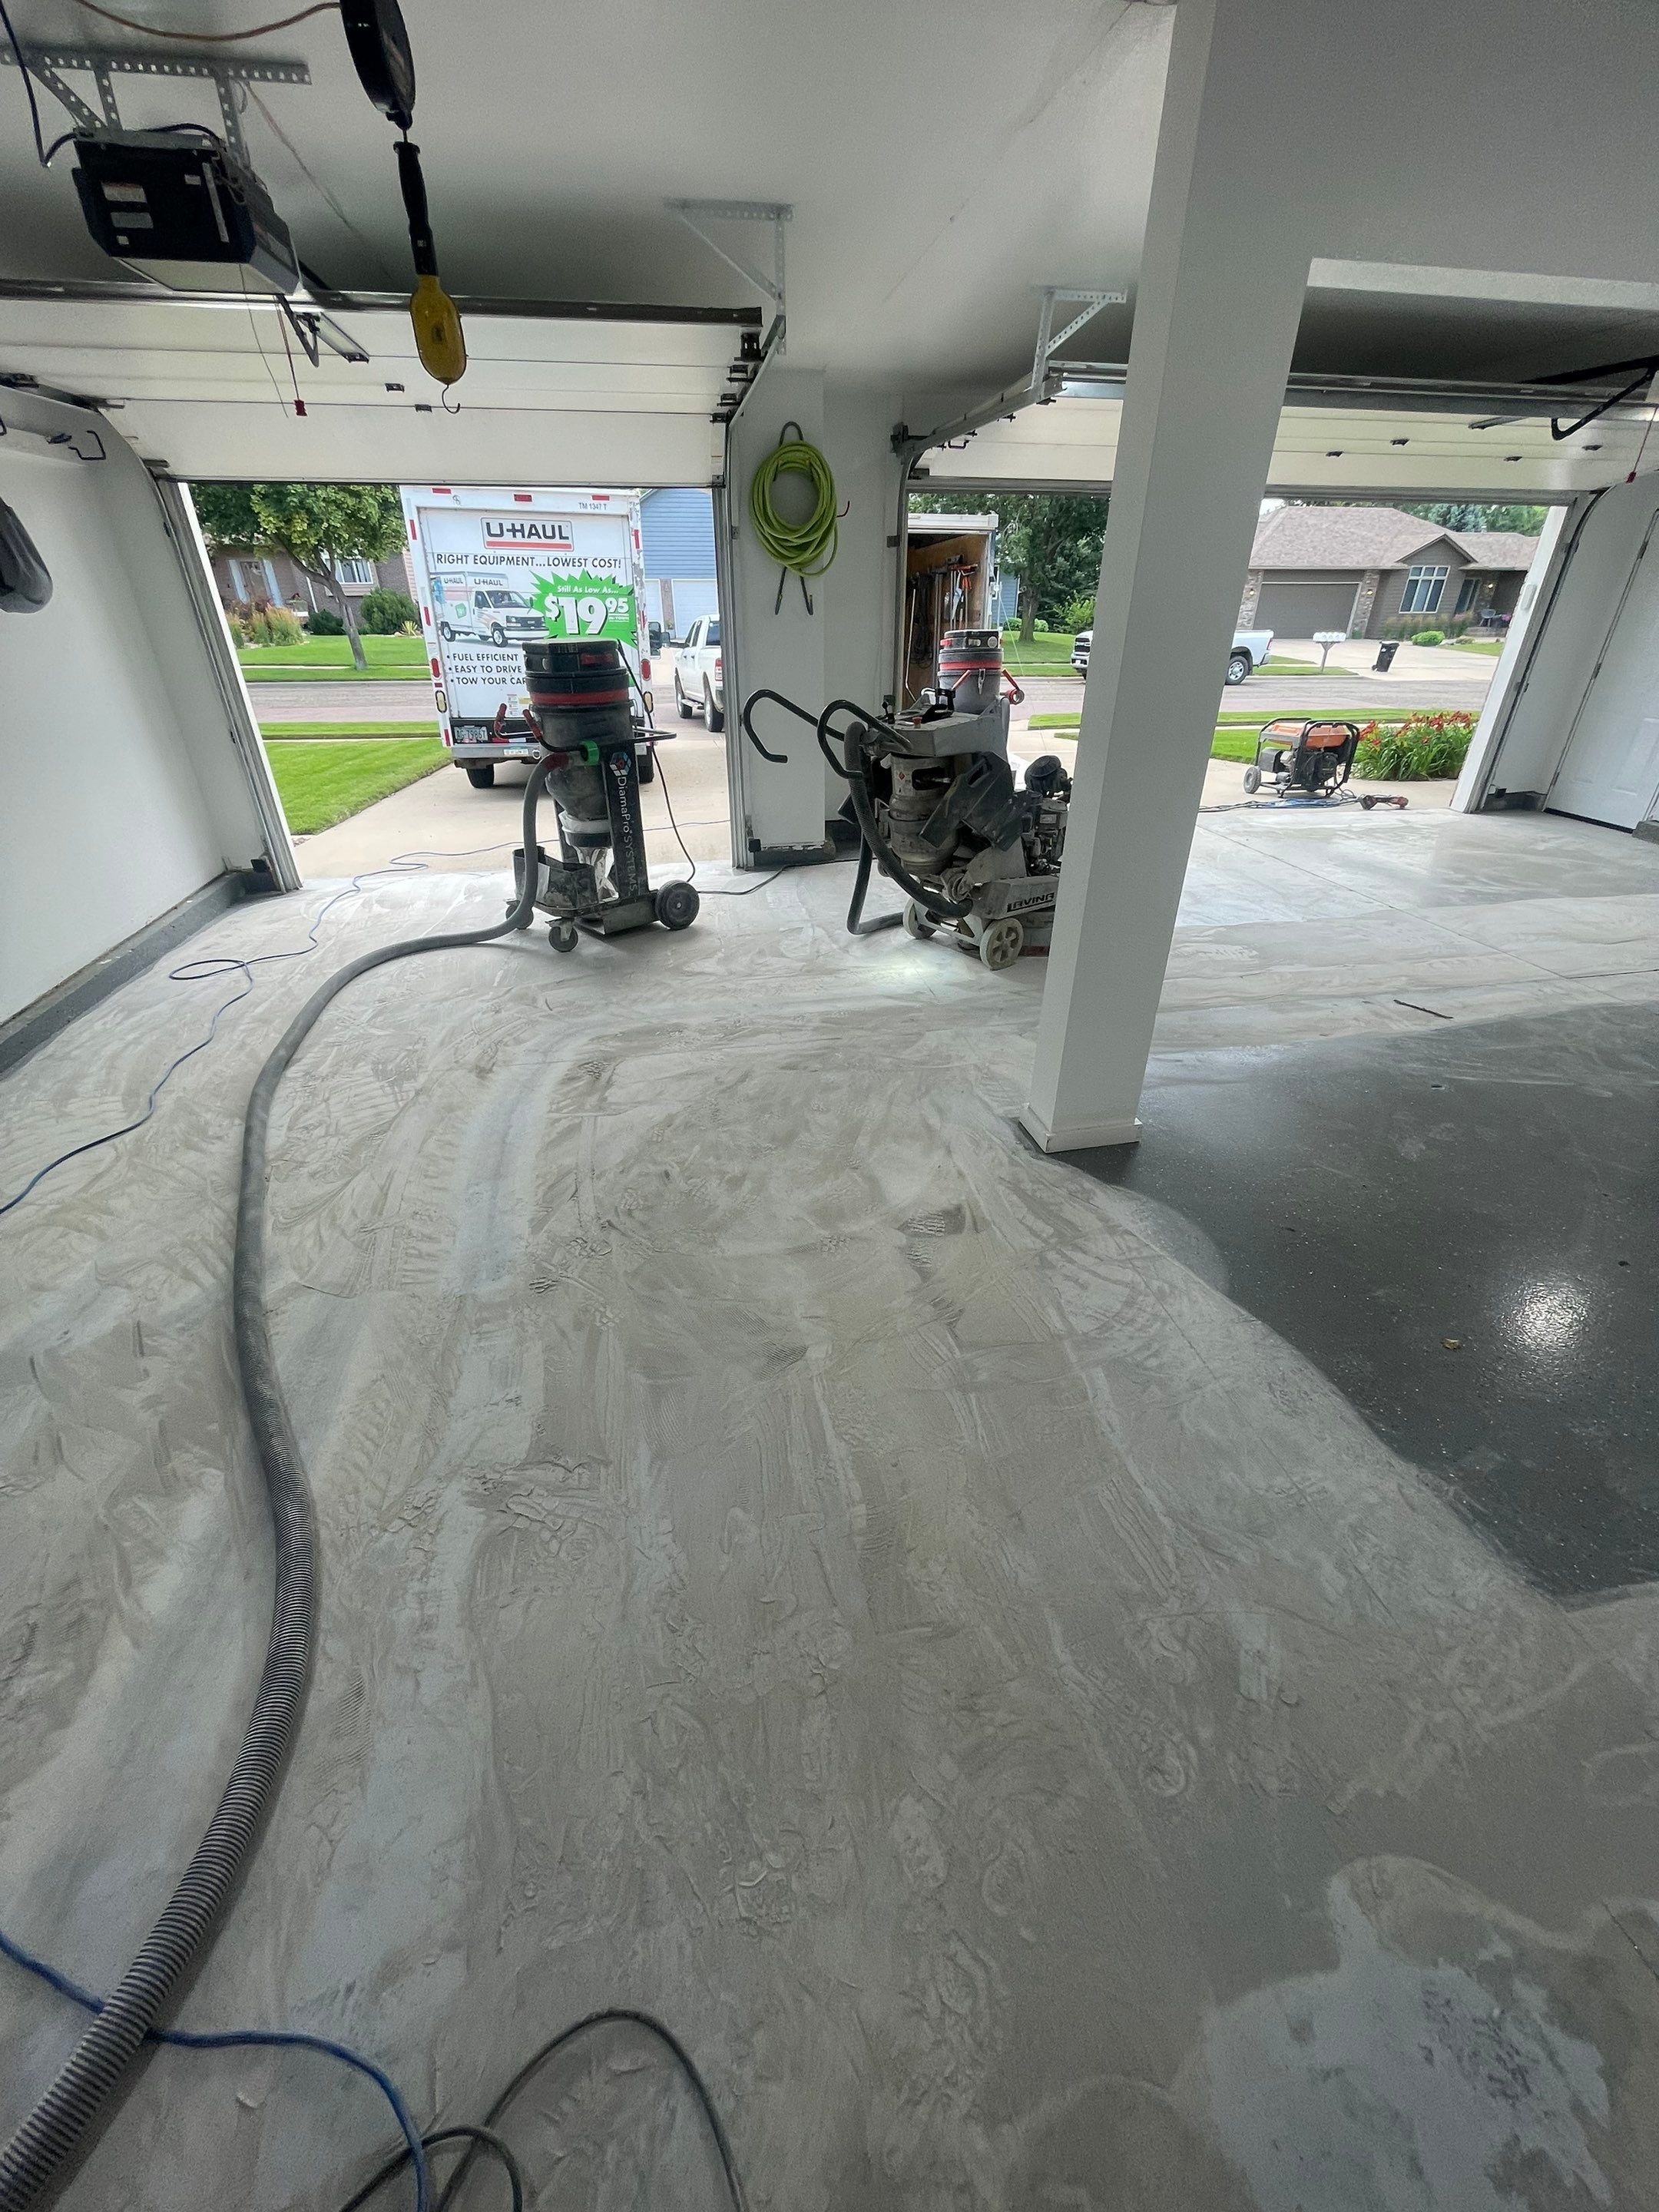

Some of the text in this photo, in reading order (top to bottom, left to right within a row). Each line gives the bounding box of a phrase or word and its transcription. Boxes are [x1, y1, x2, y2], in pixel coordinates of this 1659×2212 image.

[485, 522, 569, 540] U-HAUL
[436, 554, 469, 565] RIGHT
[591, 558, 621, 568] COST!
[618, 777, 631, 833] DiamaPro
[624, 835, 637, 891] SYSTEMS
[1007, 892, 1055, 912] LAVINA
